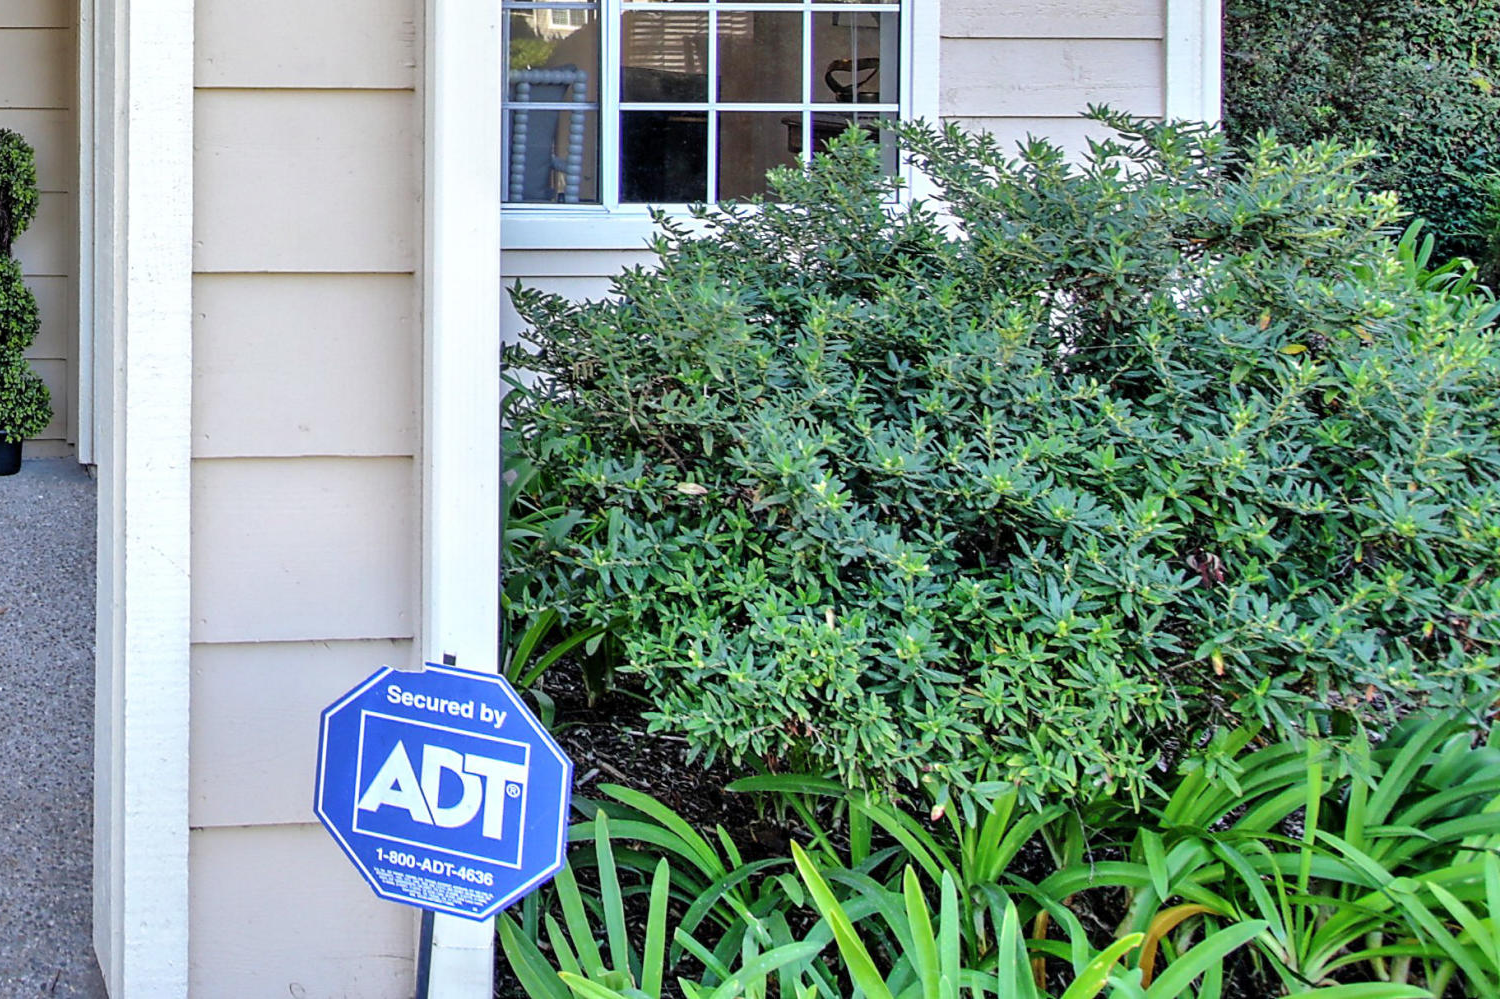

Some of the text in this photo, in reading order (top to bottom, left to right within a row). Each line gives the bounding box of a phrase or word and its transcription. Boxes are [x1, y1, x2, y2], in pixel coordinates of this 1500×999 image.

[386, 684, 507, 728] Secured by
[357, 739, 528, 840] ADT
[376, 847, 494, 886] 1-800-ADT-4636
